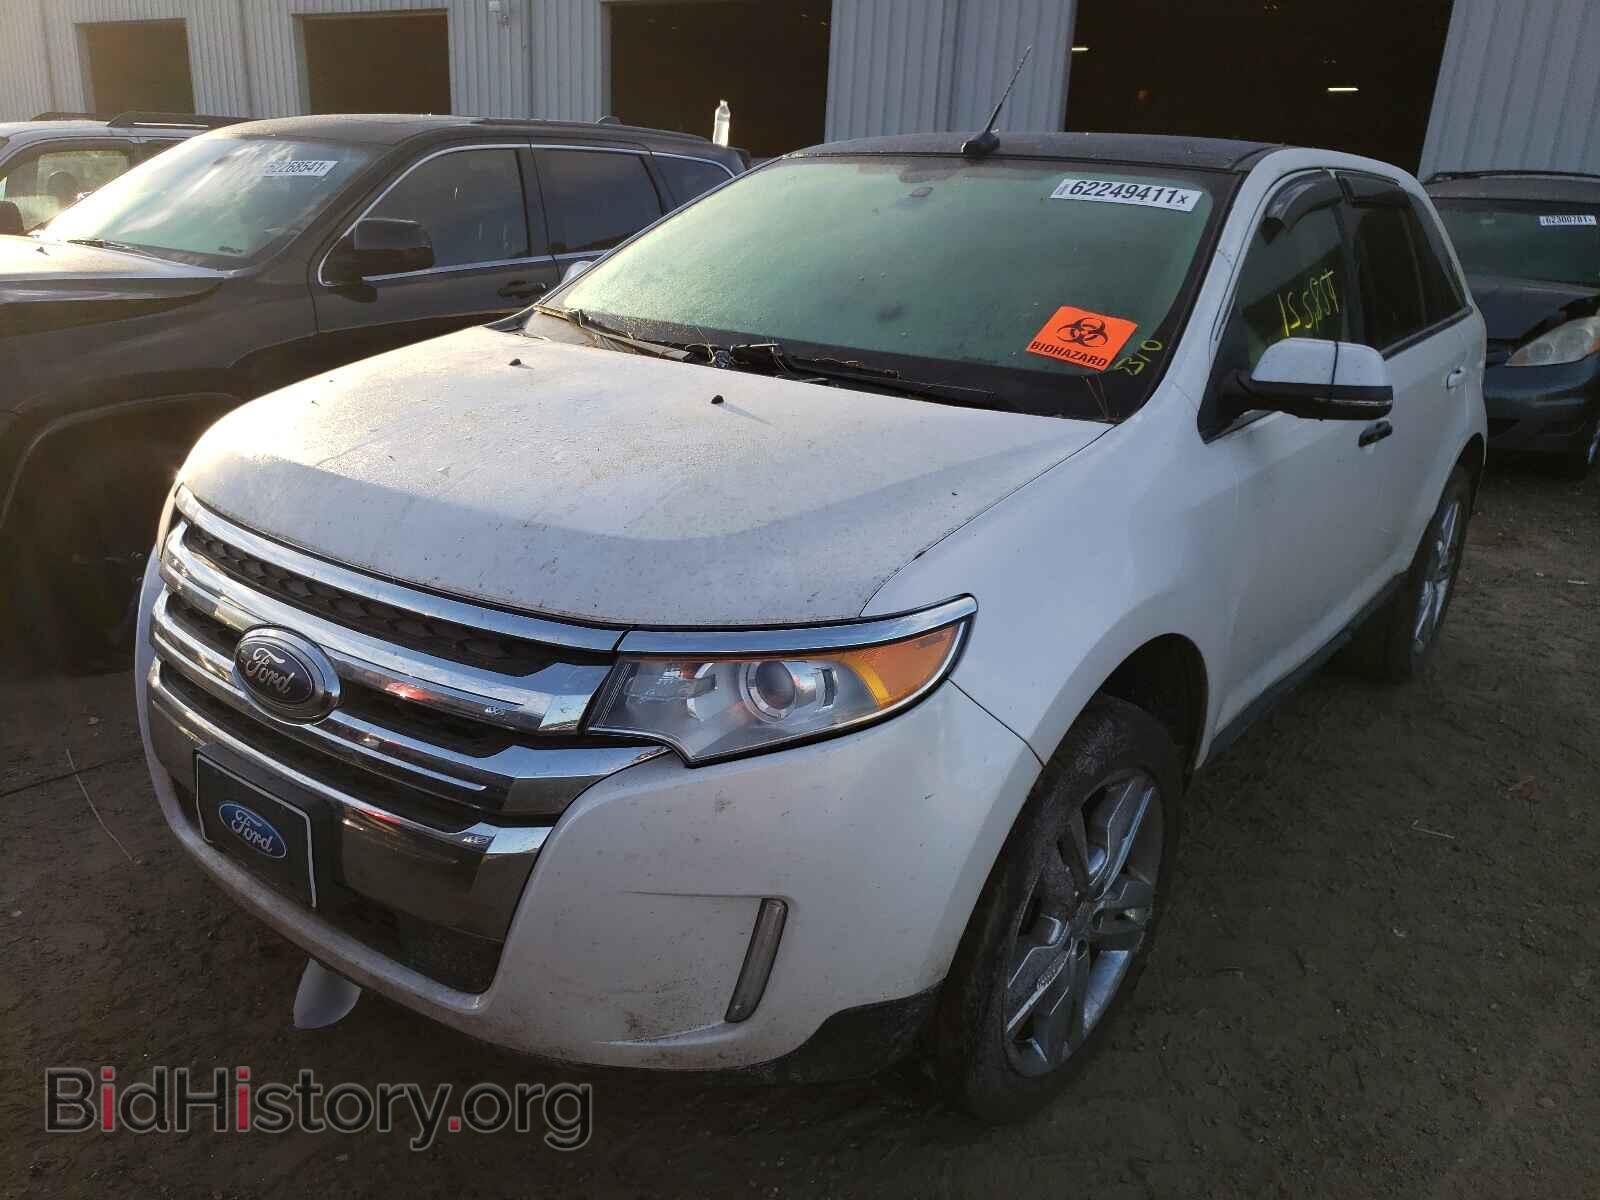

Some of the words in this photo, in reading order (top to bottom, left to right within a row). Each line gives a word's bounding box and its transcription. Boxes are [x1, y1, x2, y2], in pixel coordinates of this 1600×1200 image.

[1030, 341, 1108, 367] BIOHAZARD
[245, 647, 296, 694] Ford
[231, 809, 273, 853] Ford
